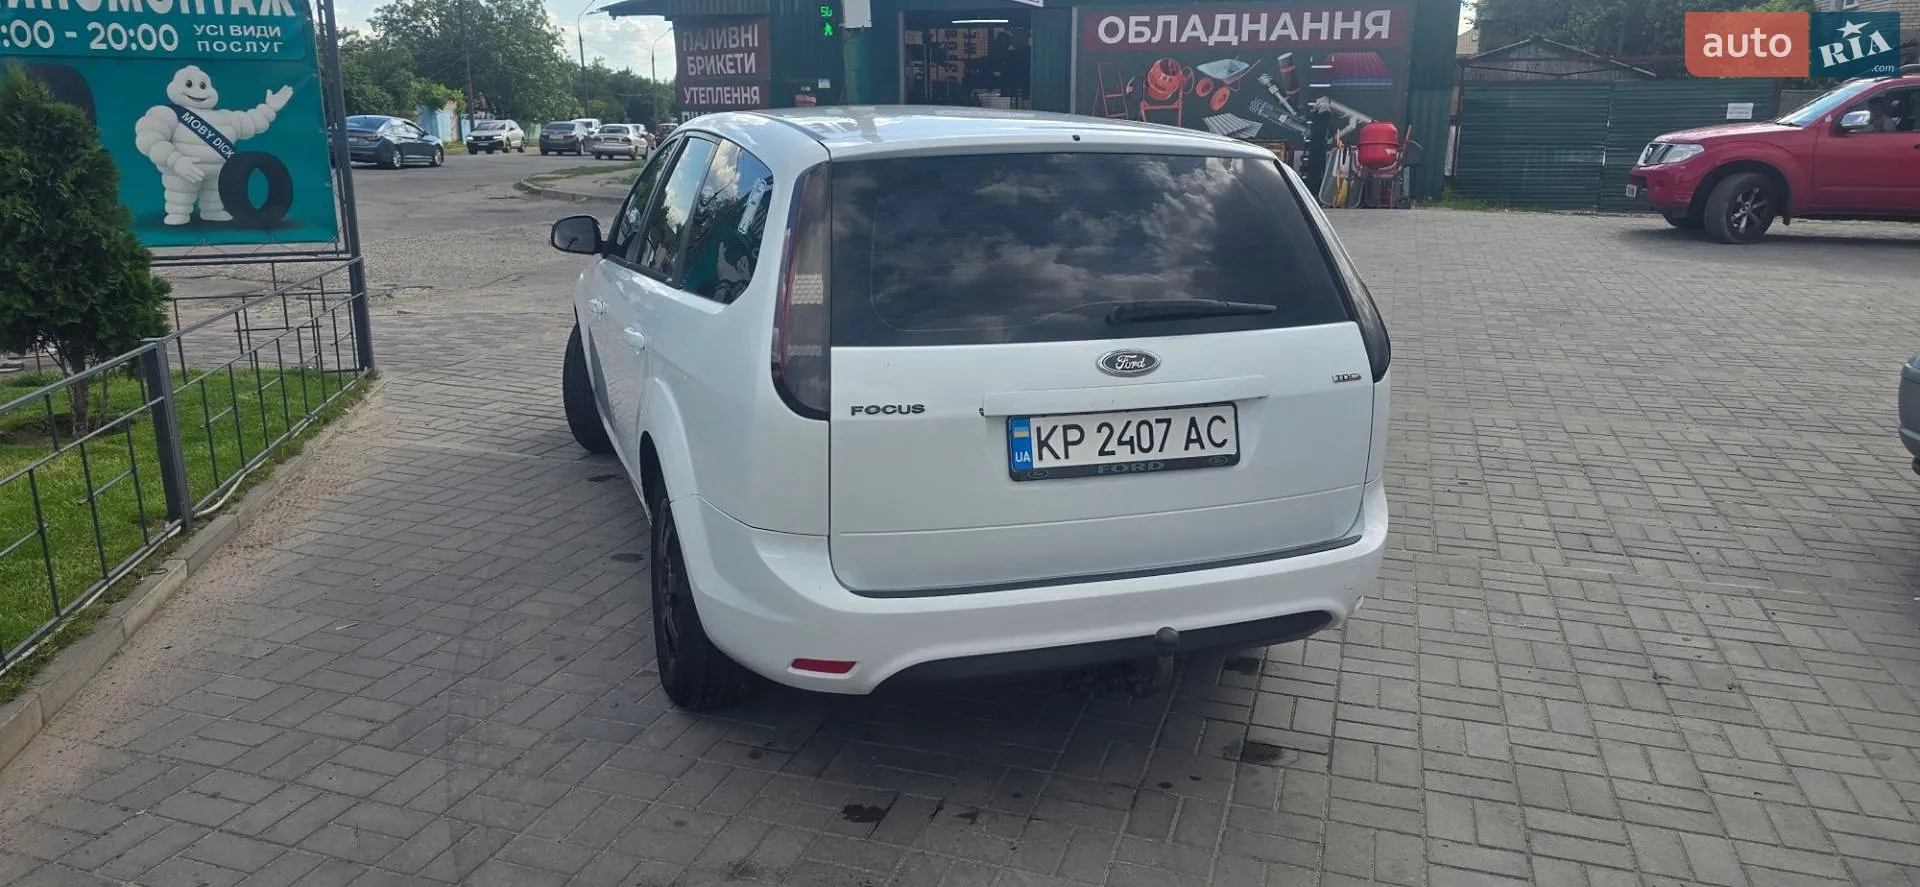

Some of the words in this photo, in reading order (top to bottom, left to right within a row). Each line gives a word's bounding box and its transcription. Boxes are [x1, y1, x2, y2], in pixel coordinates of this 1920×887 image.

[87, 22, 179, 51] 20:00
[193, 24, 225, 36] УСІ
[229, 25, 281, 39] ВИДИ
[1097, 10, 1392, 46] ОБЛАДНАННЯ
[197, 41, 283, 53] ПОСЛУГ
[683, 24, 758, 52] ПАЛИВНІ
[686, 53, 756, 76] БРИКЕТИ
[683, 86, 760, 104] УТЕПЛЕННЯ
[181, 112, 216, 139] MOBY
[213, 137, 236, 158] DICK
[1115, 355, 1146, 370] Ford
[851, 404, 926, 416] FOCUS
[1036, 423, 1085, 461] KP
[1096, 418, 1172, 457] 2407
[1184, 415, 1228, 451] AC
[1015, 451, 1031, 463] UA
[1097, 461, 1165, 474] FORD
